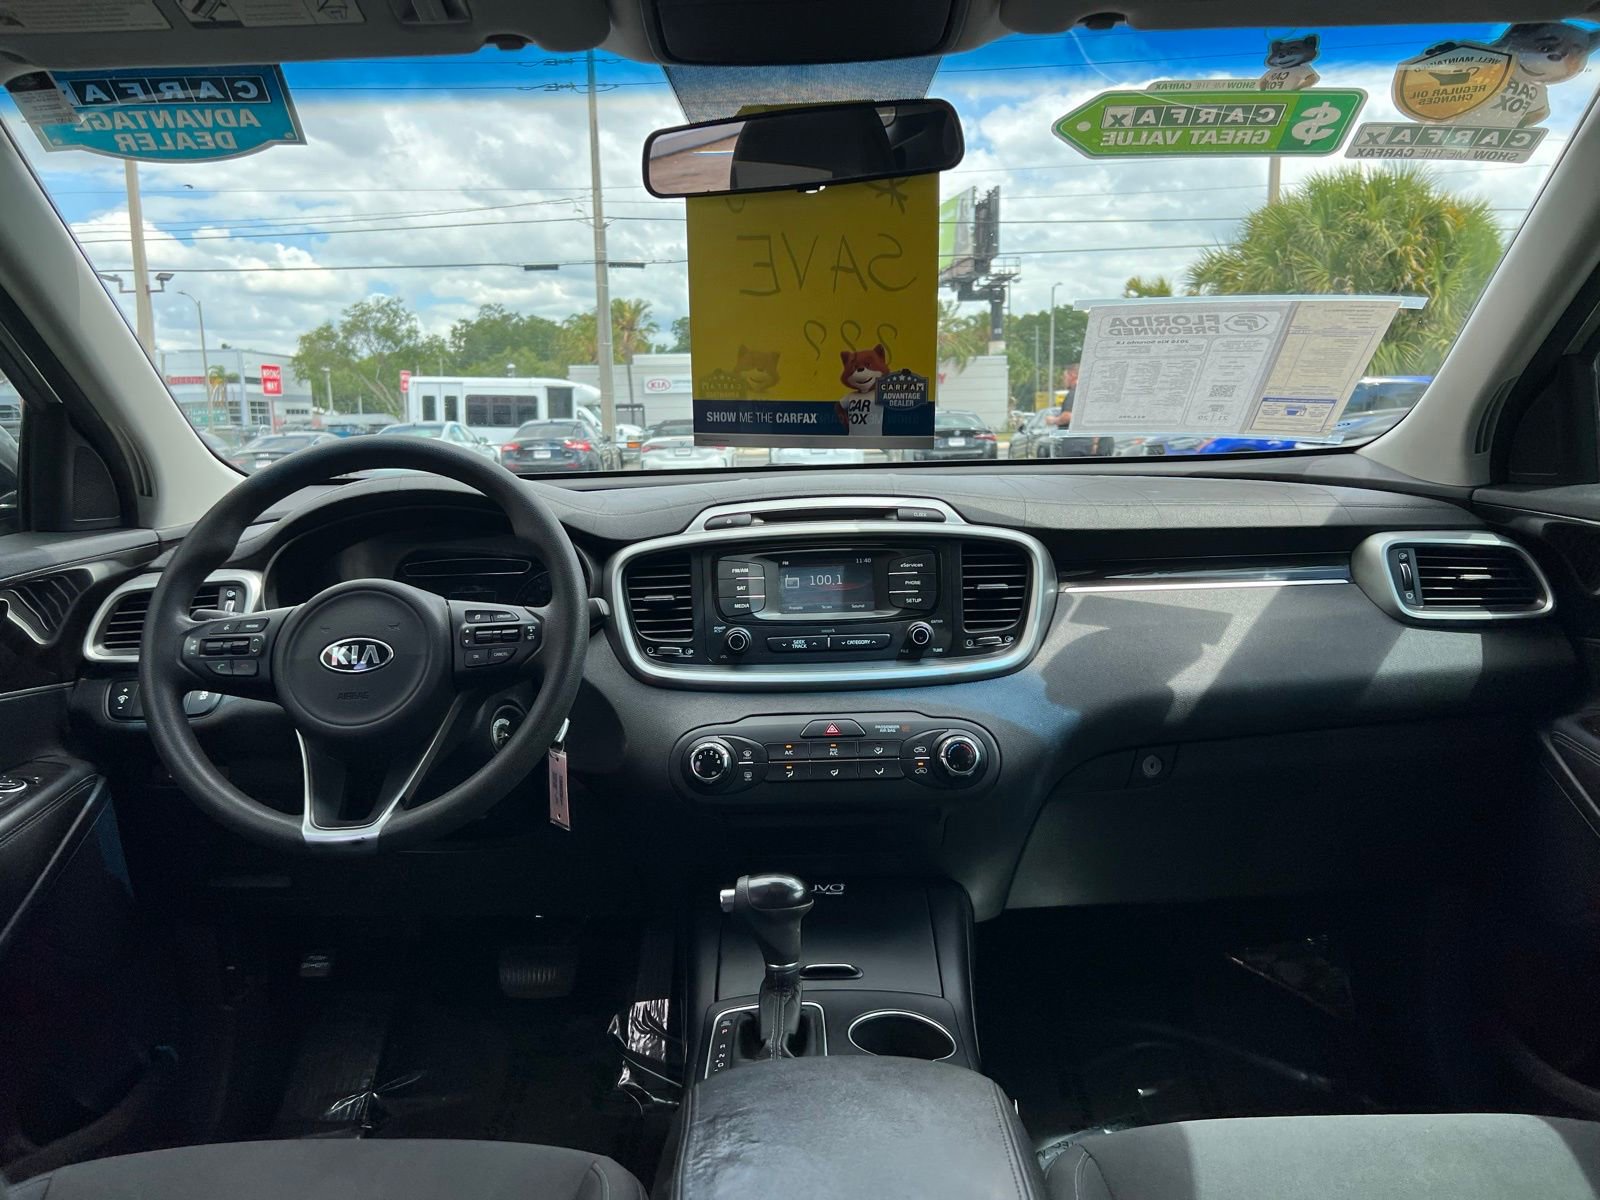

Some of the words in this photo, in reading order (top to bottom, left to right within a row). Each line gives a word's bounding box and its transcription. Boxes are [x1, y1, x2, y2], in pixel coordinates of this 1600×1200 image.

[883, 392, 921, 400] ADVANTAGE
[849, 399, 871, 413] CAR
[889, 399, 914, 407] DEALER
[706, 411, 737, 423] SHOW
[739, 412, 754, 423] ME
[755, 412, 773, 424] THE
[776, 412, 818, 424] CARFAX
[809, 574, 843, 587] 100.1
[331, 644, 381, 666] KIA
